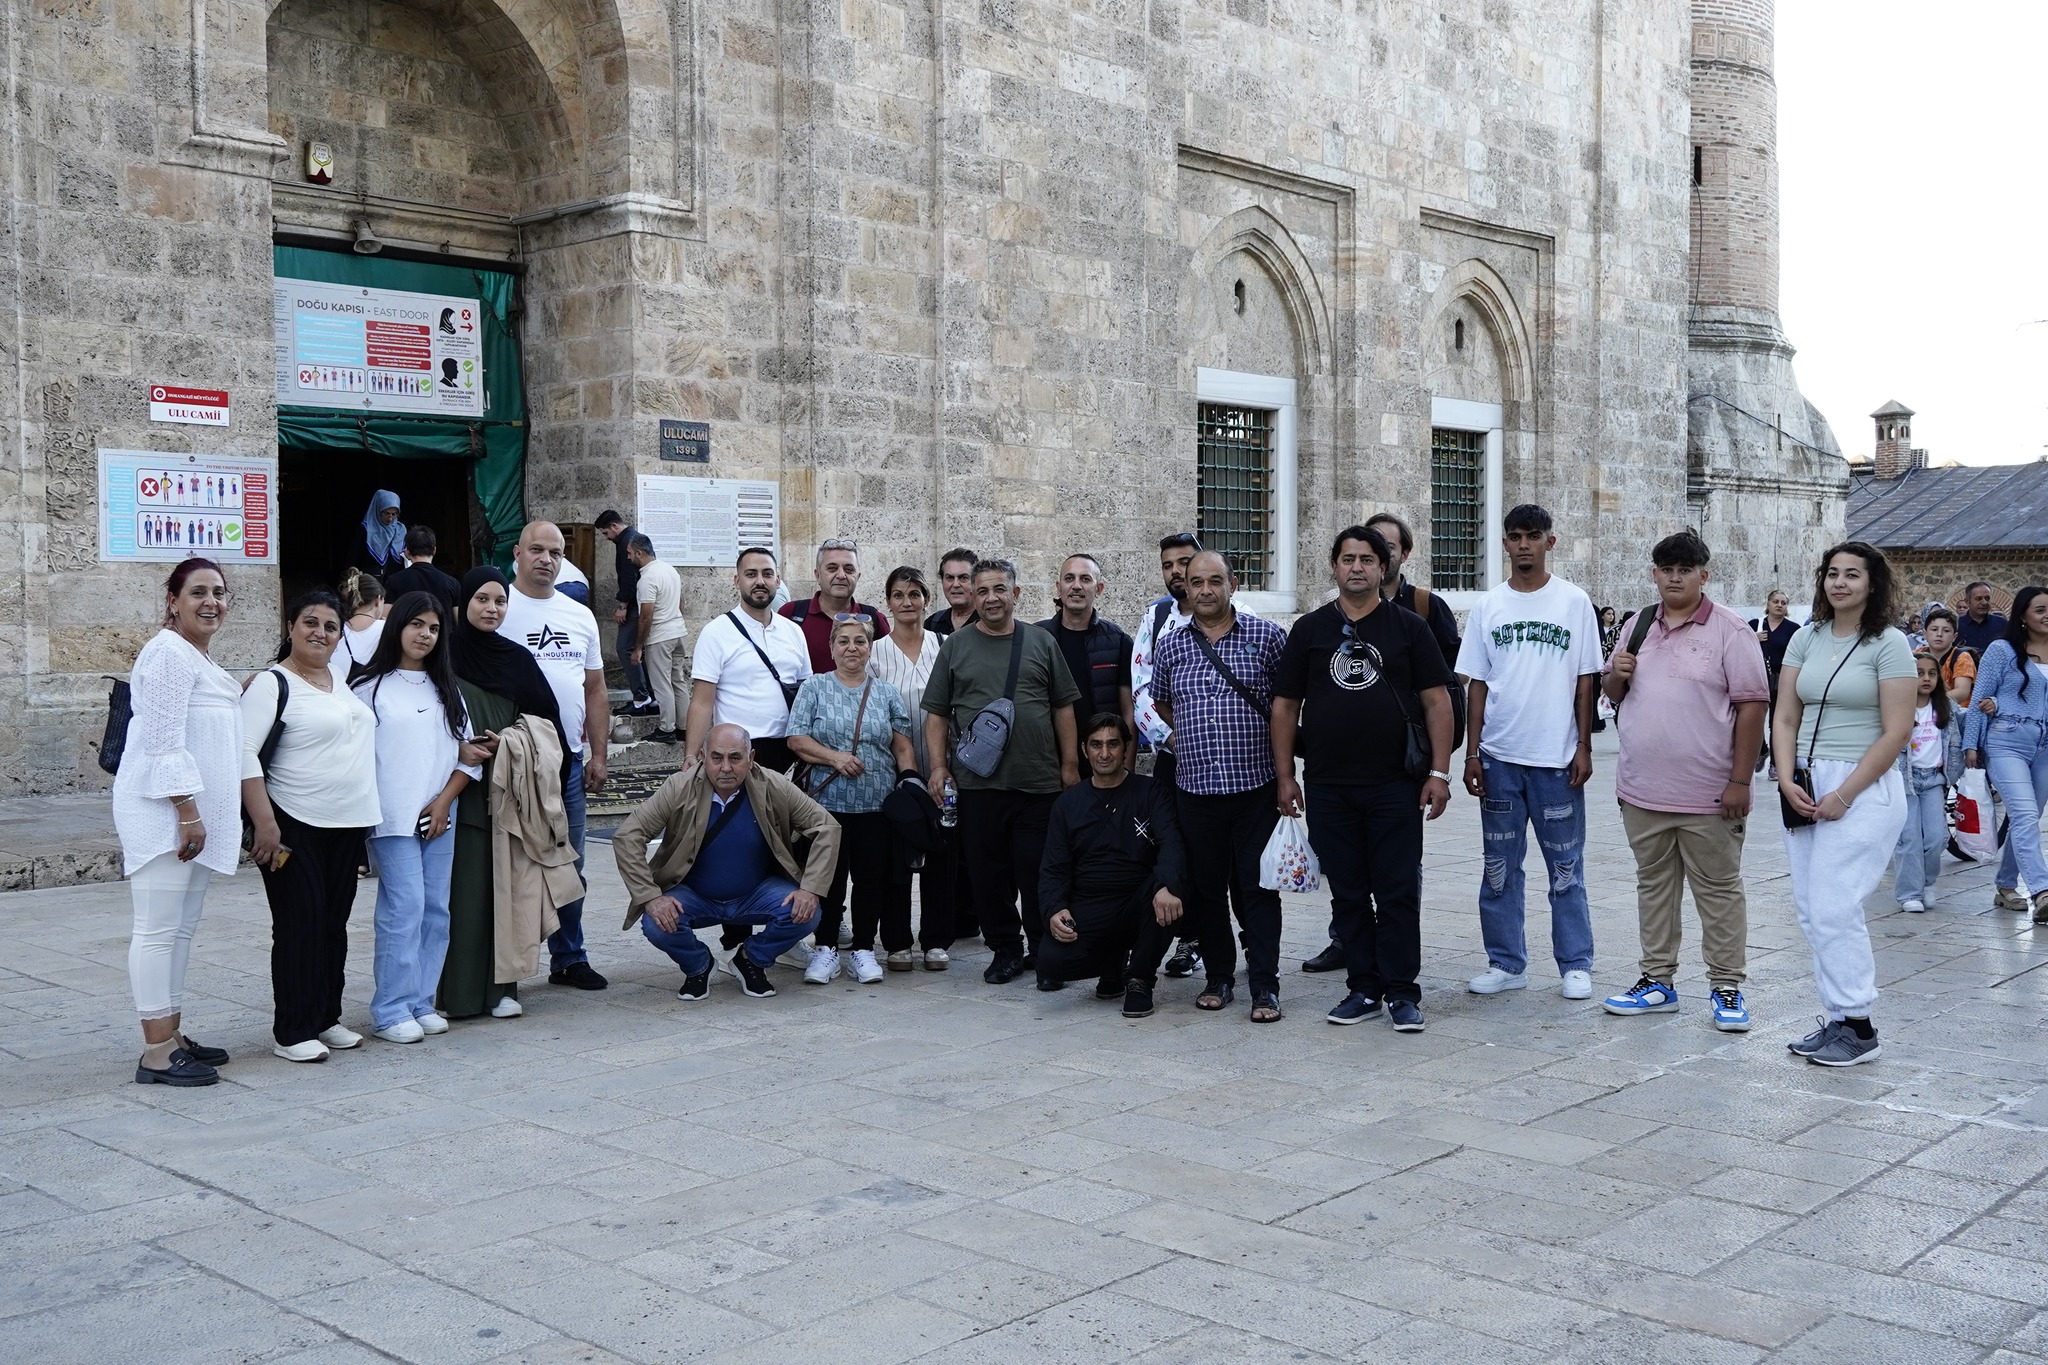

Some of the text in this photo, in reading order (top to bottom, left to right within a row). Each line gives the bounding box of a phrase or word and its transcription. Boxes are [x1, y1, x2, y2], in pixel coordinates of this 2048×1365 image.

[297, 299, 328, 310] DOĞU
[332, 303, 364, 314] KAPISI
[374, 307, 397, 317] EAST
[400, 310, 429, 320] DOOR
[168, 408, 221, 420] ULU CAMİİ
[664, 427, 708, 441] ULUCAMİ
[675, 445, 697, 455] 1399
[1491, 621, 1571, 651] NOTHING
